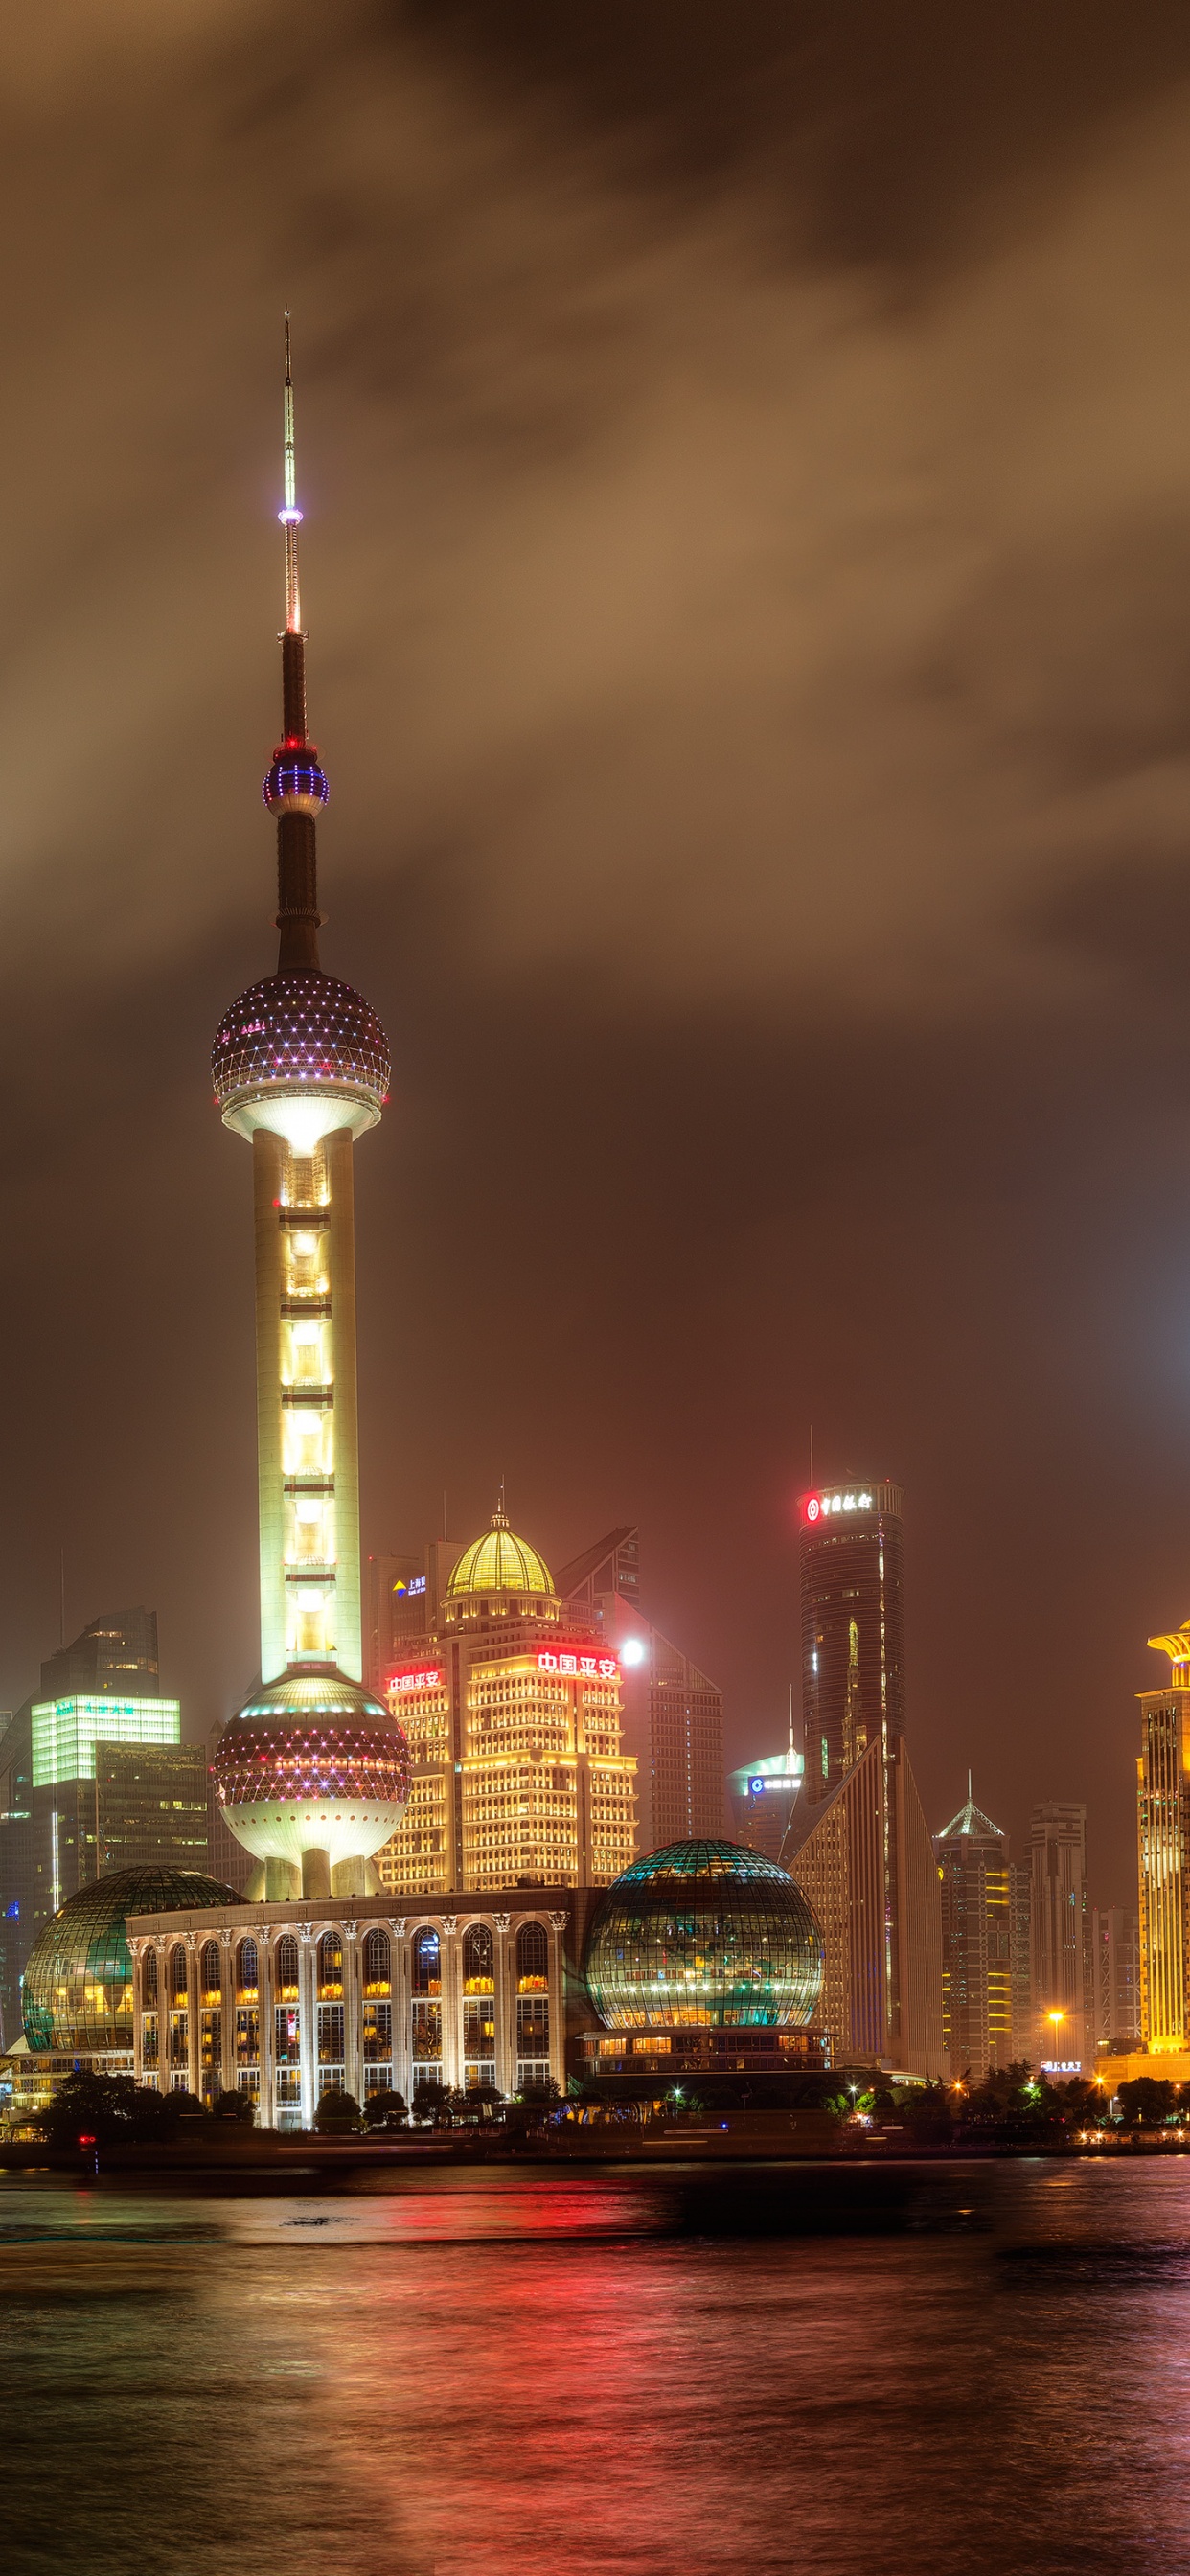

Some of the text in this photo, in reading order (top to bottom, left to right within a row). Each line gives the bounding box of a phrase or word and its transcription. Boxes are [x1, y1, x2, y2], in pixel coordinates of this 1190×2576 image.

[538, 1652, 616, 1679] 中国平安
[390, 1671, 439, 1690] 中国平安
